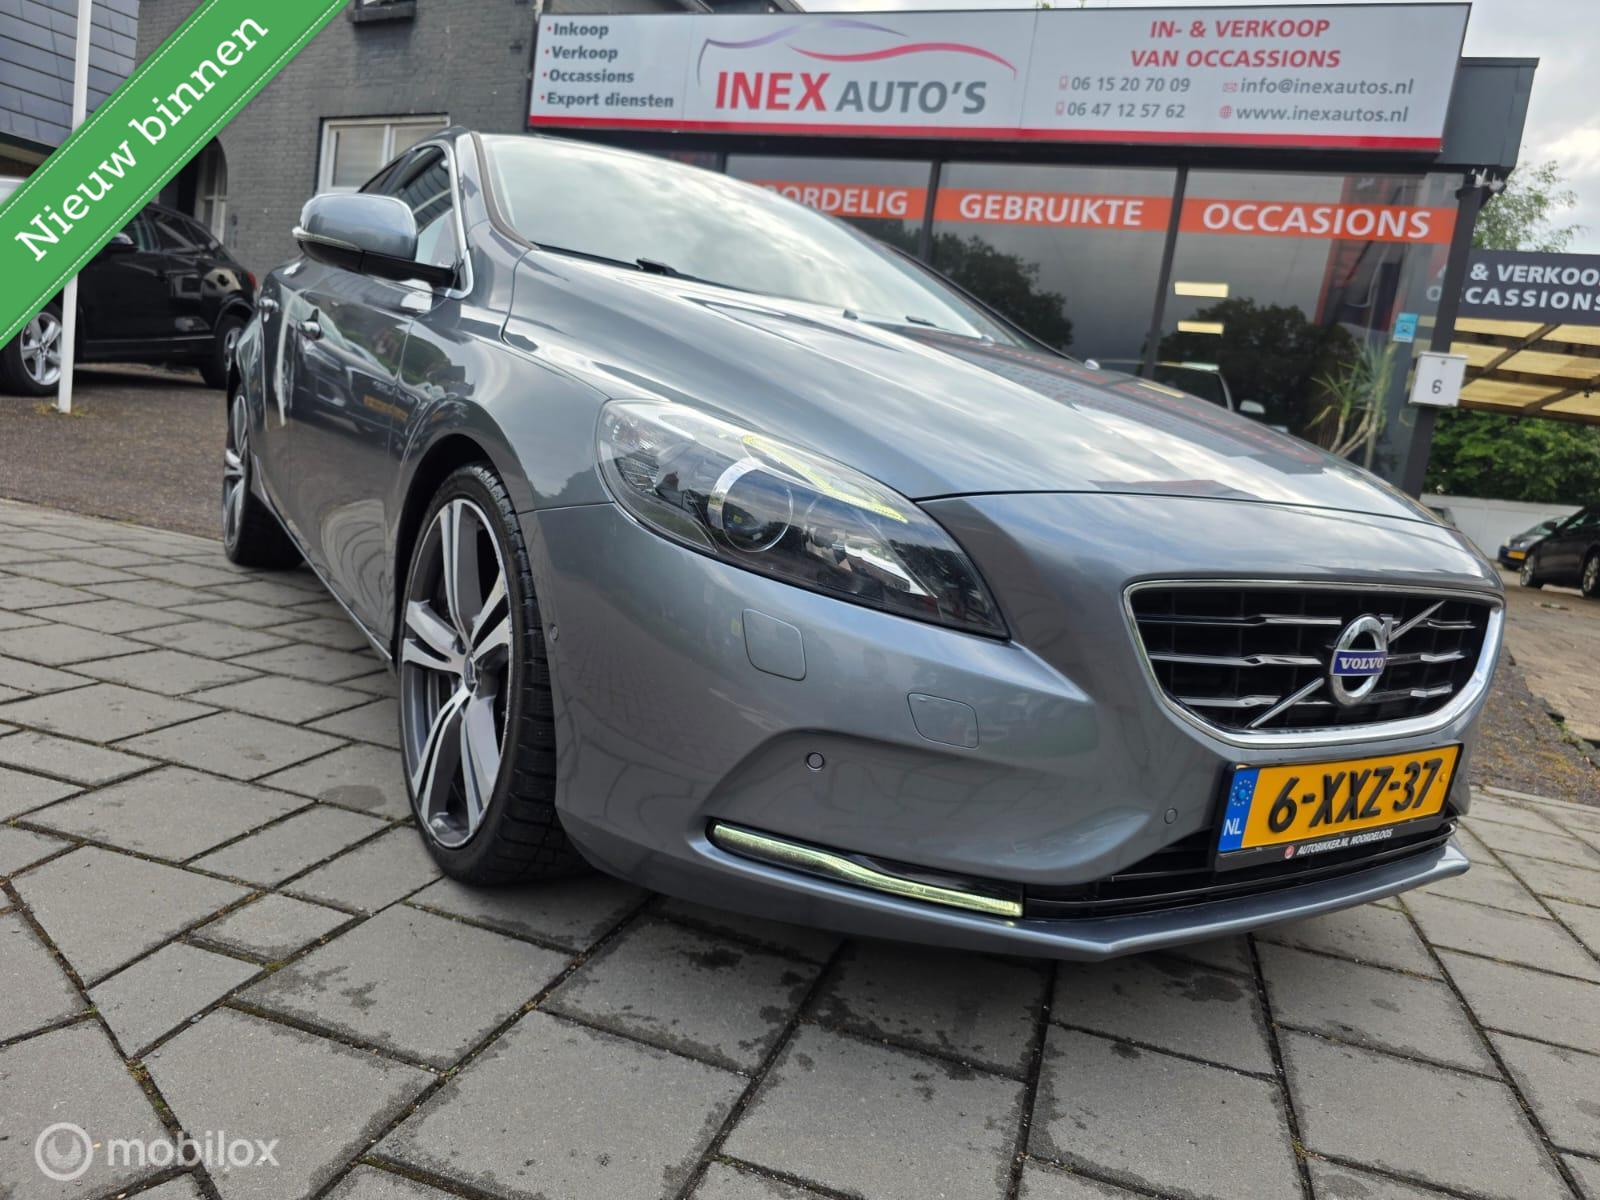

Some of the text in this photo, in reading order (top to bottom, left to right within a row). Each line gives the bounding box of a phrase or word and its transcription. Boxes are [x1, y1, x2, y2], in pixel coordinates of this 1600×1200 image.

[553, 22, 609, 39] Inkoop
[1150, 19, 1330, 38] IN- & VERKOOP
[551, 45, 618, 63] Verkoop
[1131, 49, 1342, 69] VAN OCCASSIONS
[549, 68, 635, 83] Occassions
[1071, 76, 1191, 93] 06 15 20 70 09
[715, 71, 831, 111] INEX
[1240, 77, 1415, 95] info@inexautos.nl
[546, 92, 674, 109] Export diensten
[1067, 102, 1186, 119] 06 47 12 57 62
[1235, 105, 1410, 123] www.inexautos.nl
[958, 193, 1144, 227] GEBRUIKTE
[1201, 202, 1431, 240] OCCASIONS
[1470, 263, 1600, 287] & VERKOO
[1431, 379, 1443, 395] 6
[1338, 656, 1384, 670] VOLVO
[1267, 757, 1444, 834] 6-XXZ-37
[1223, 817, 1243, 837] NL
